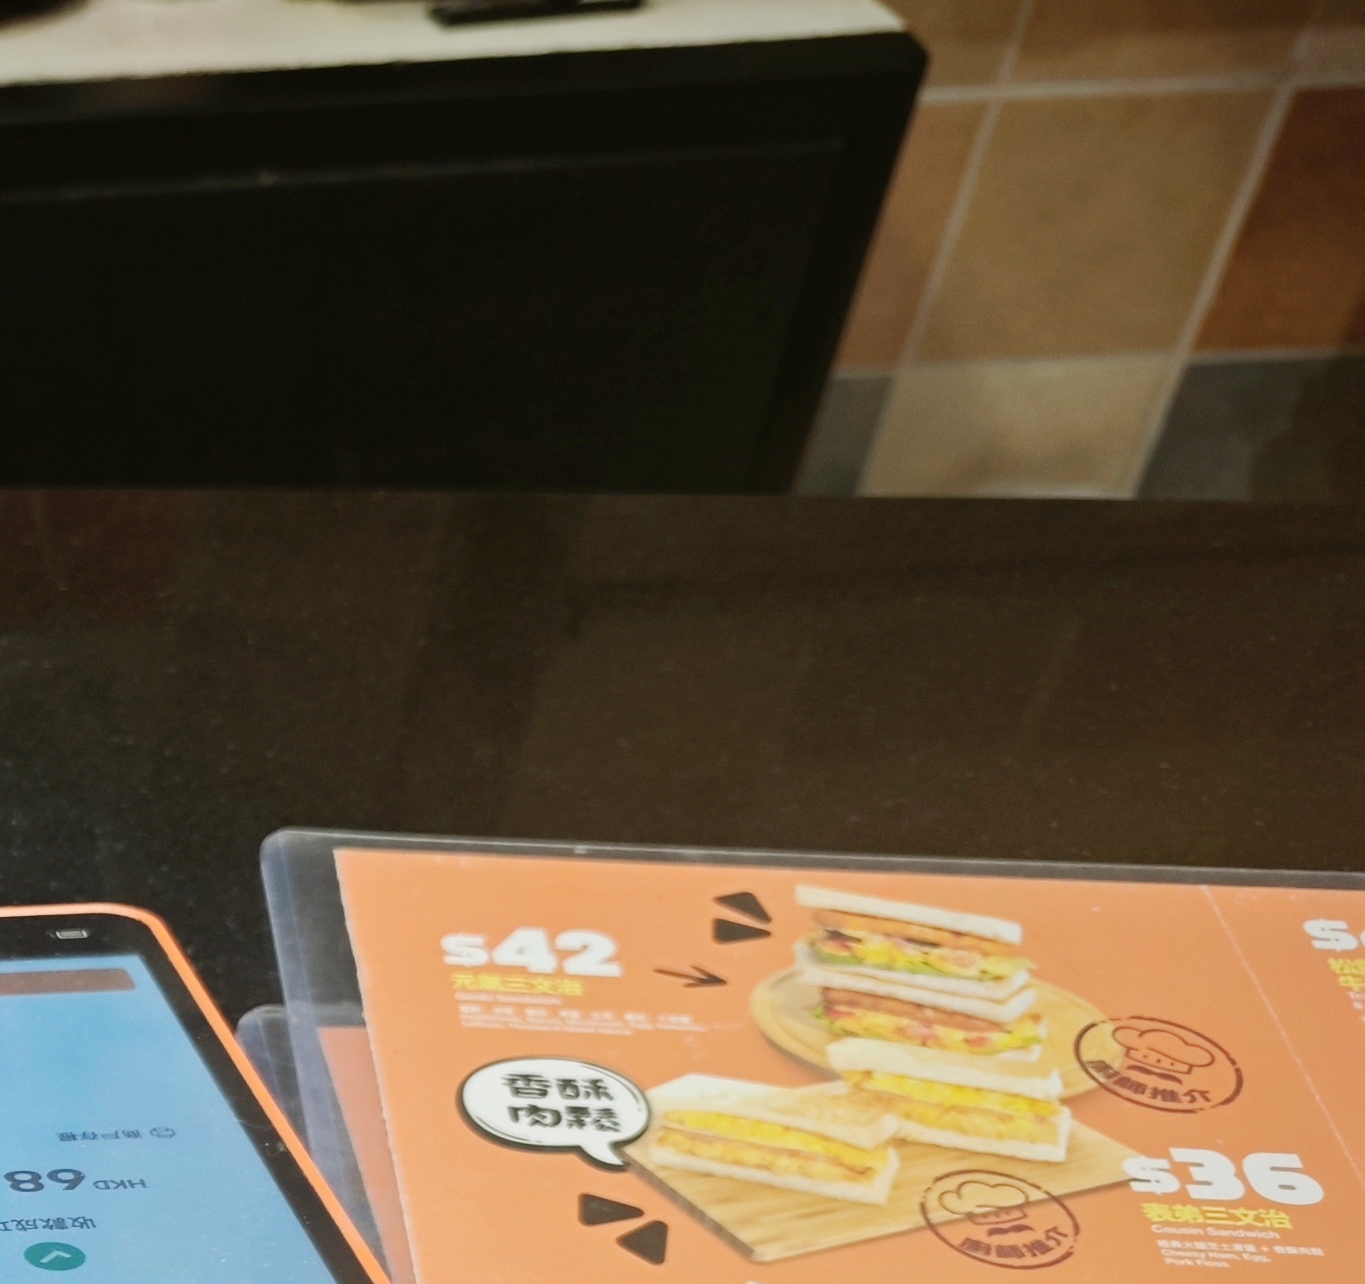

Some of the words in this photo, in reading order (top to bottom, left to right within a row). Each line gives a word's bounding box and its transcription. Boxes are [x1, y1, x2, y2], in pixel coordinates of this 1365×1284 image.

[441, 927, 621, 977] $42
[501, 1073, 614, 1101] 香酥
[507, 1104, 621, 1133] 肉鬆
[93, 1176, 147, 1191] HKD
[1123, 1148, 1324, 1205] $36
[1208, 1227, 1280, 1239] Sandwich
